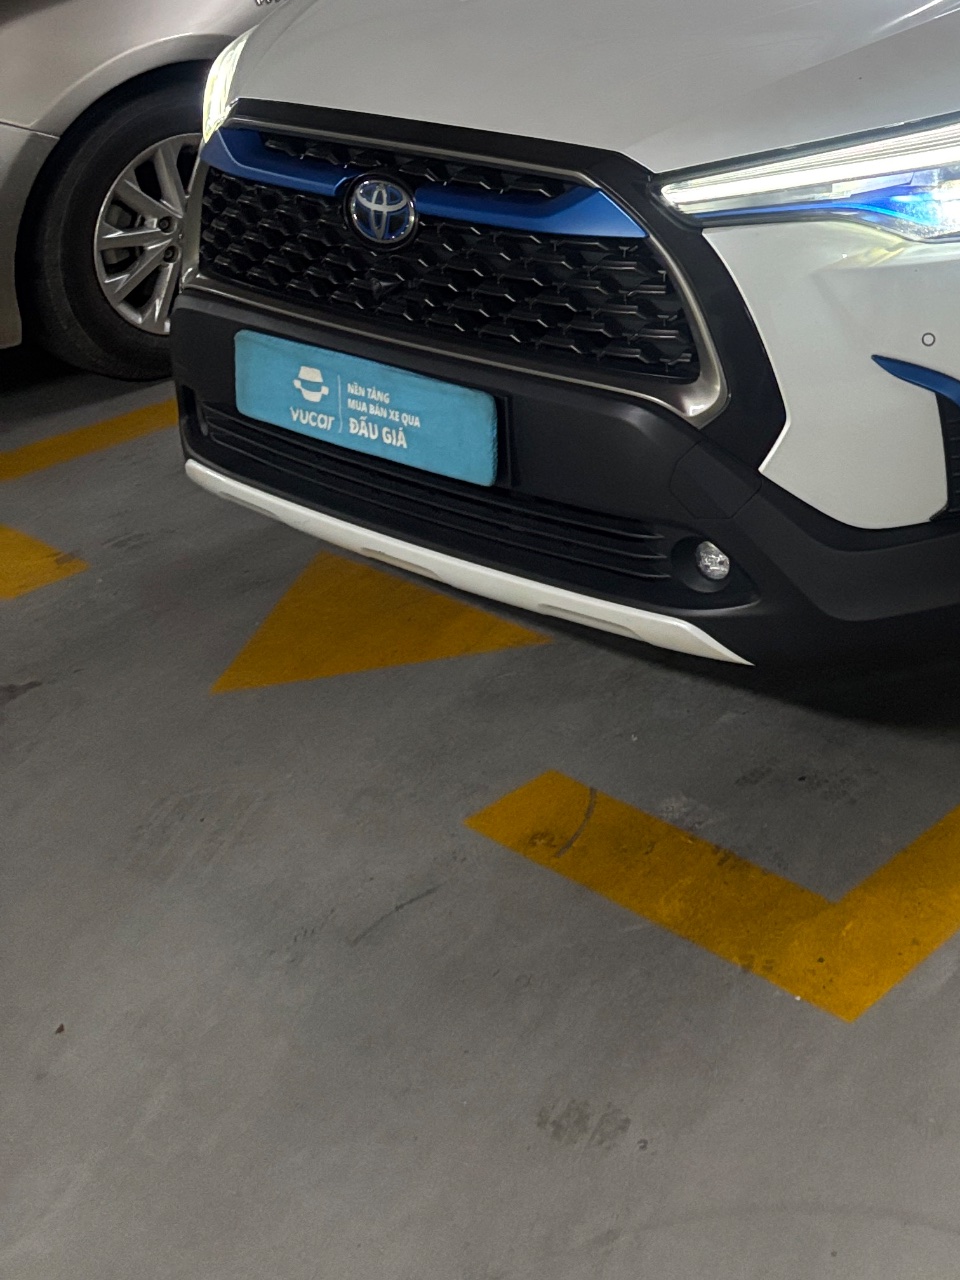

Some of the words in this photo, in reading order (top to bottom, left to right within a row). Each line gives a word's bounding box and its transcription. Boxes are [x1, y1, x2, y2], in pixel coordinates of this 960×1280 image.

[289, 406, 335, 431] vucar
[347, 398, 368, 413] MUA
[369, 403, 388, 419] BÁN
[388, 409, 400, 422] XE
[401, 412, 421, 428] QUA
[382, 426, 408, 449] GIÁ
